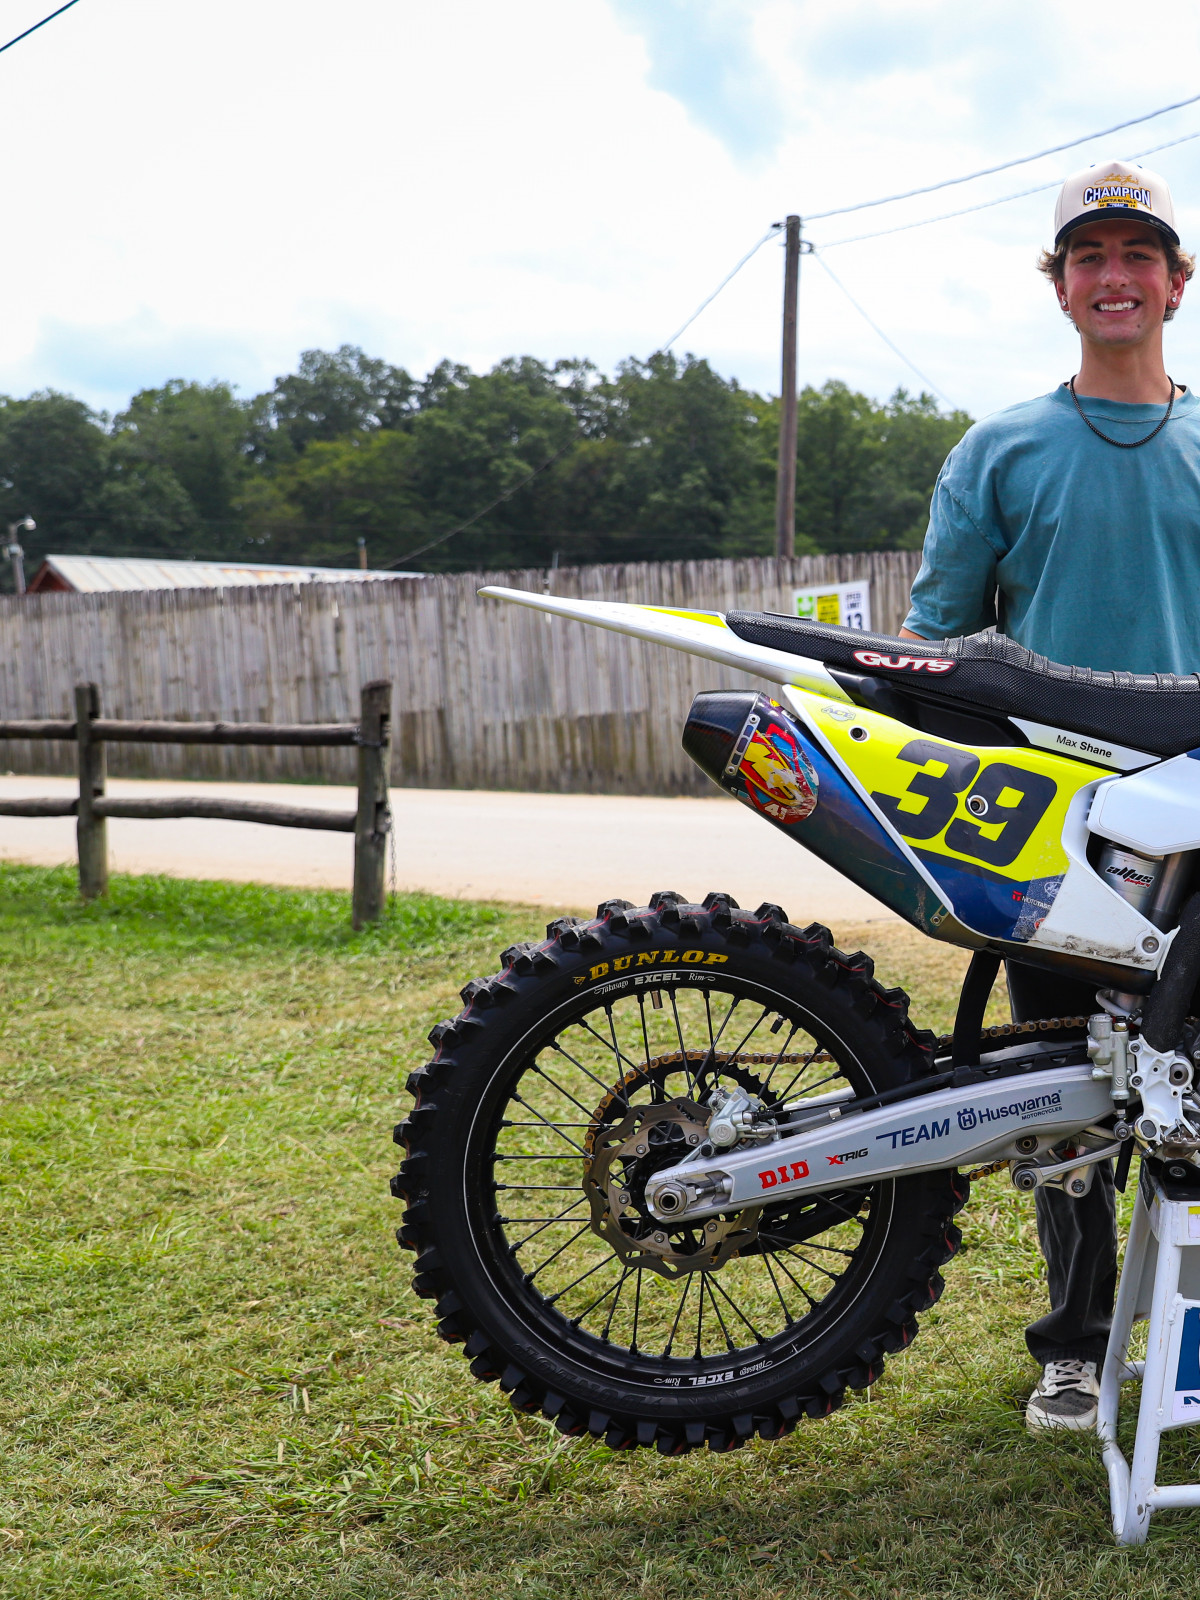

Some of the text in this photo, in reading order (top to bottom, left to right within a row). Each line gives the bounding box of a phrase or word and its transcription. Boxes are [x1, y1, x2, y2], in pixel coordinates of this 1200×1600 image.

[1084, 187, 1151, 208] CHAMPION
[853, 651, 956, 673] GUTS
[1056, 734, 1112, 758] Max Shane
[871, 739, 1058, 868] 39
[589, 950, 728, 981] DUNLOP
[602, 973, 705, 995] Takasago EXCEL Rim
[876, 1118, 950, 1149] TEAM
[978, 1092, 1061, 1124] Husqvarna
[1021, 1106, 1062, 1120] MOTORCYCLES
[758, 1147, 869, 1189] D.I.D XTRIG
[689, 1371, 734, 1385] EXCEL
[740, 1360, 766, 1376] Takasago
[665, 1378, 681, 1386] Rim
